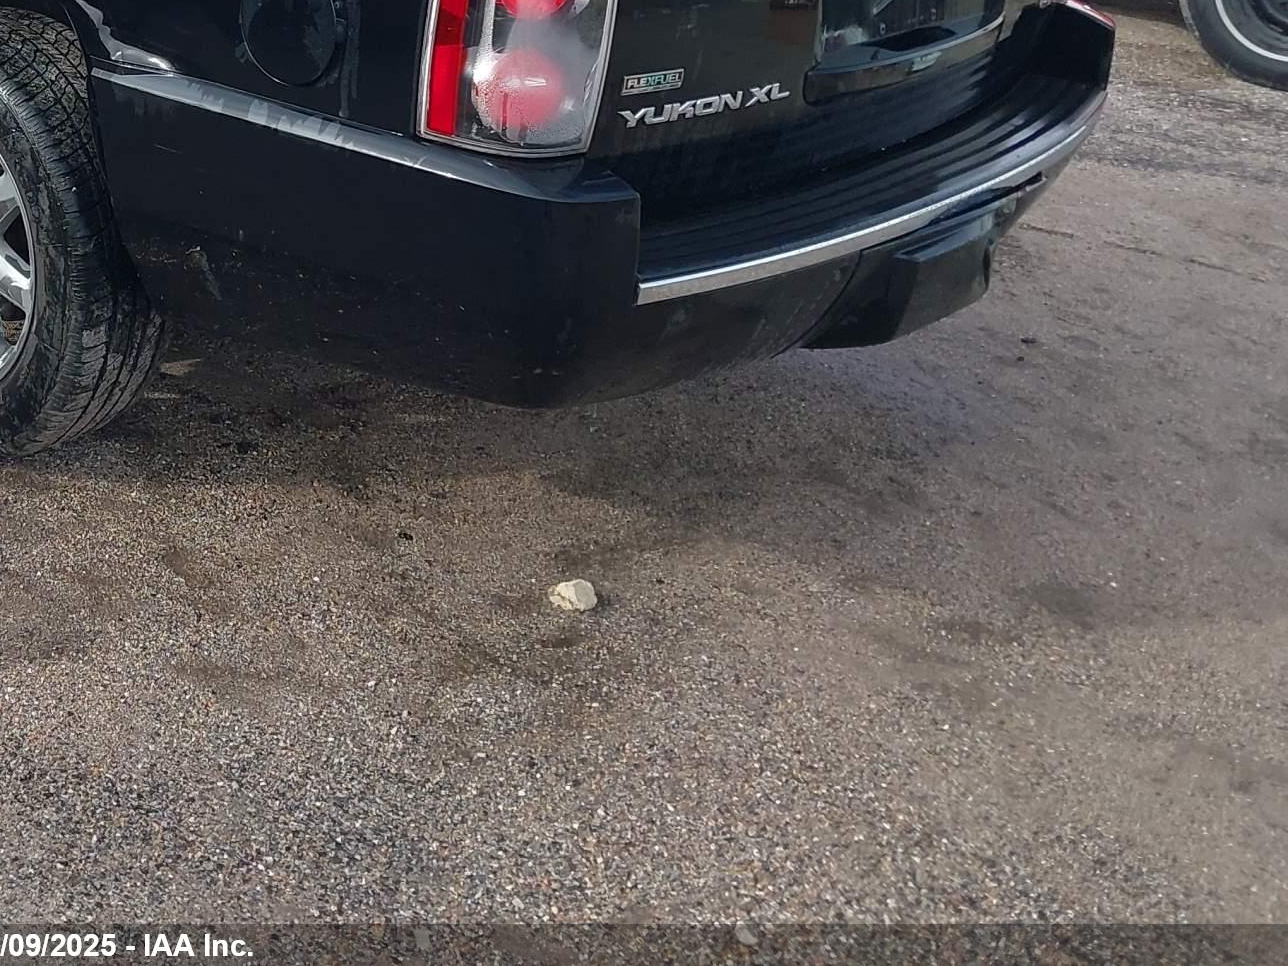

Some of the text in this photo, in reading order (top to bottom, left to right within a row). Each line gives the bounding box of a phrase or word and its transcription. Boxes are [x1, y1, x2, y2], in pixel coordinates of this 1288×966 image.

[627, 73, 681, 89] FLEXFUEL
[617, 82, 791, 128] YUKON XL
